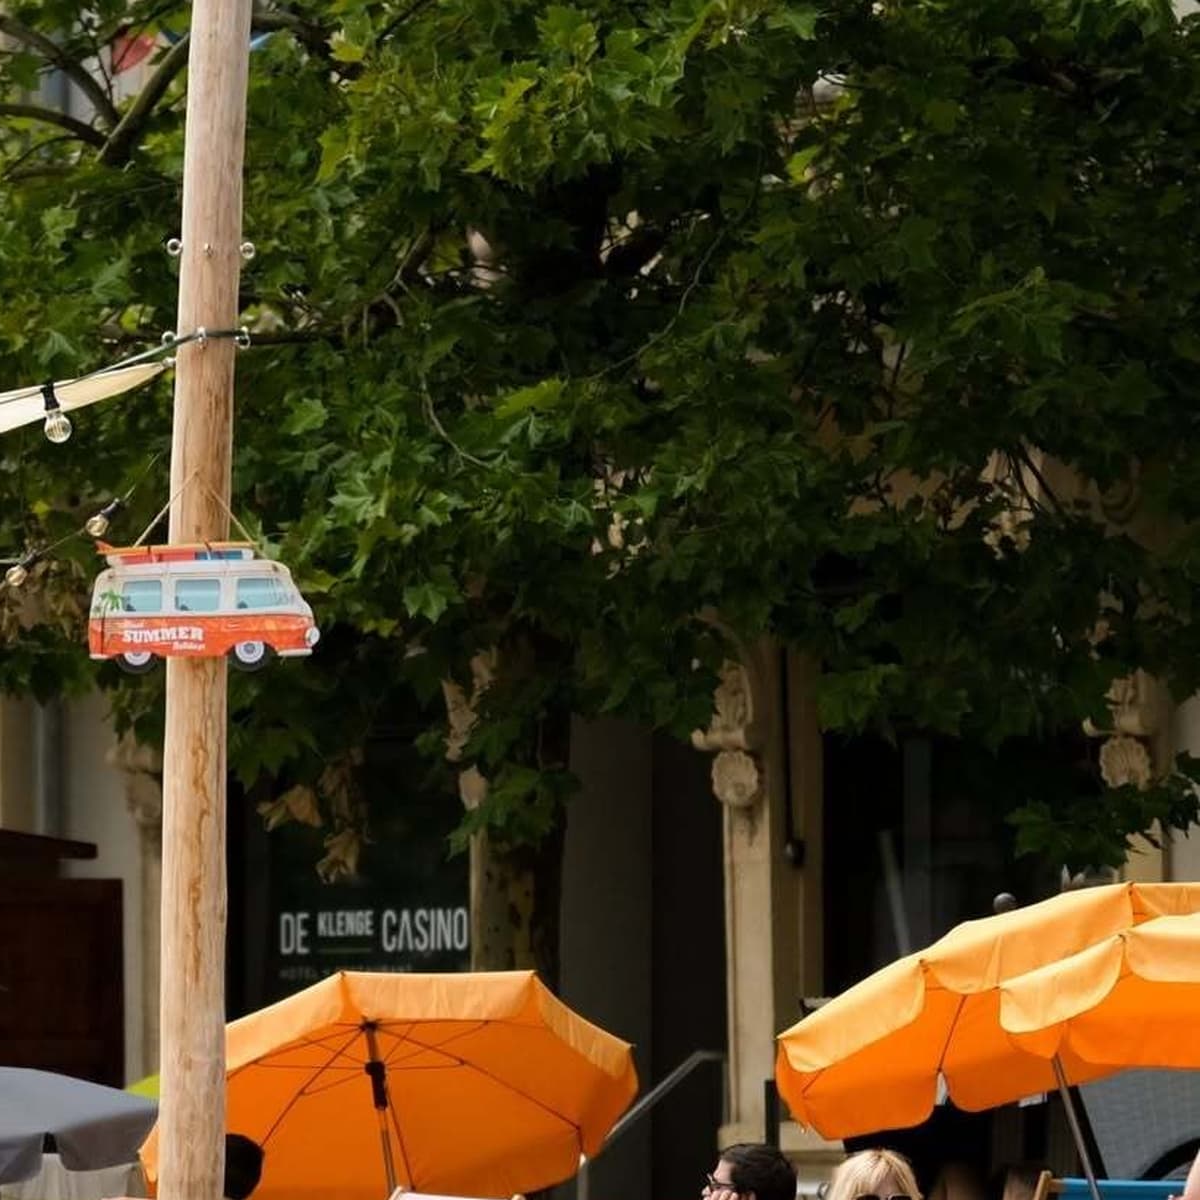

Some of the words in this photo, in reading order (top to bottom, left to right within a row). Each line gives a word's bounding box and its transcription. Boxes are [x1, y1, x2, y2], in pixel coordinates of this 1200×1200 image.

[122, 627, 204, 643] SUMMER
[280, 912, 309, 954] DE
[318, 911, 373, 936] KLENGE
[382, 908, 468, 952] CASINO
